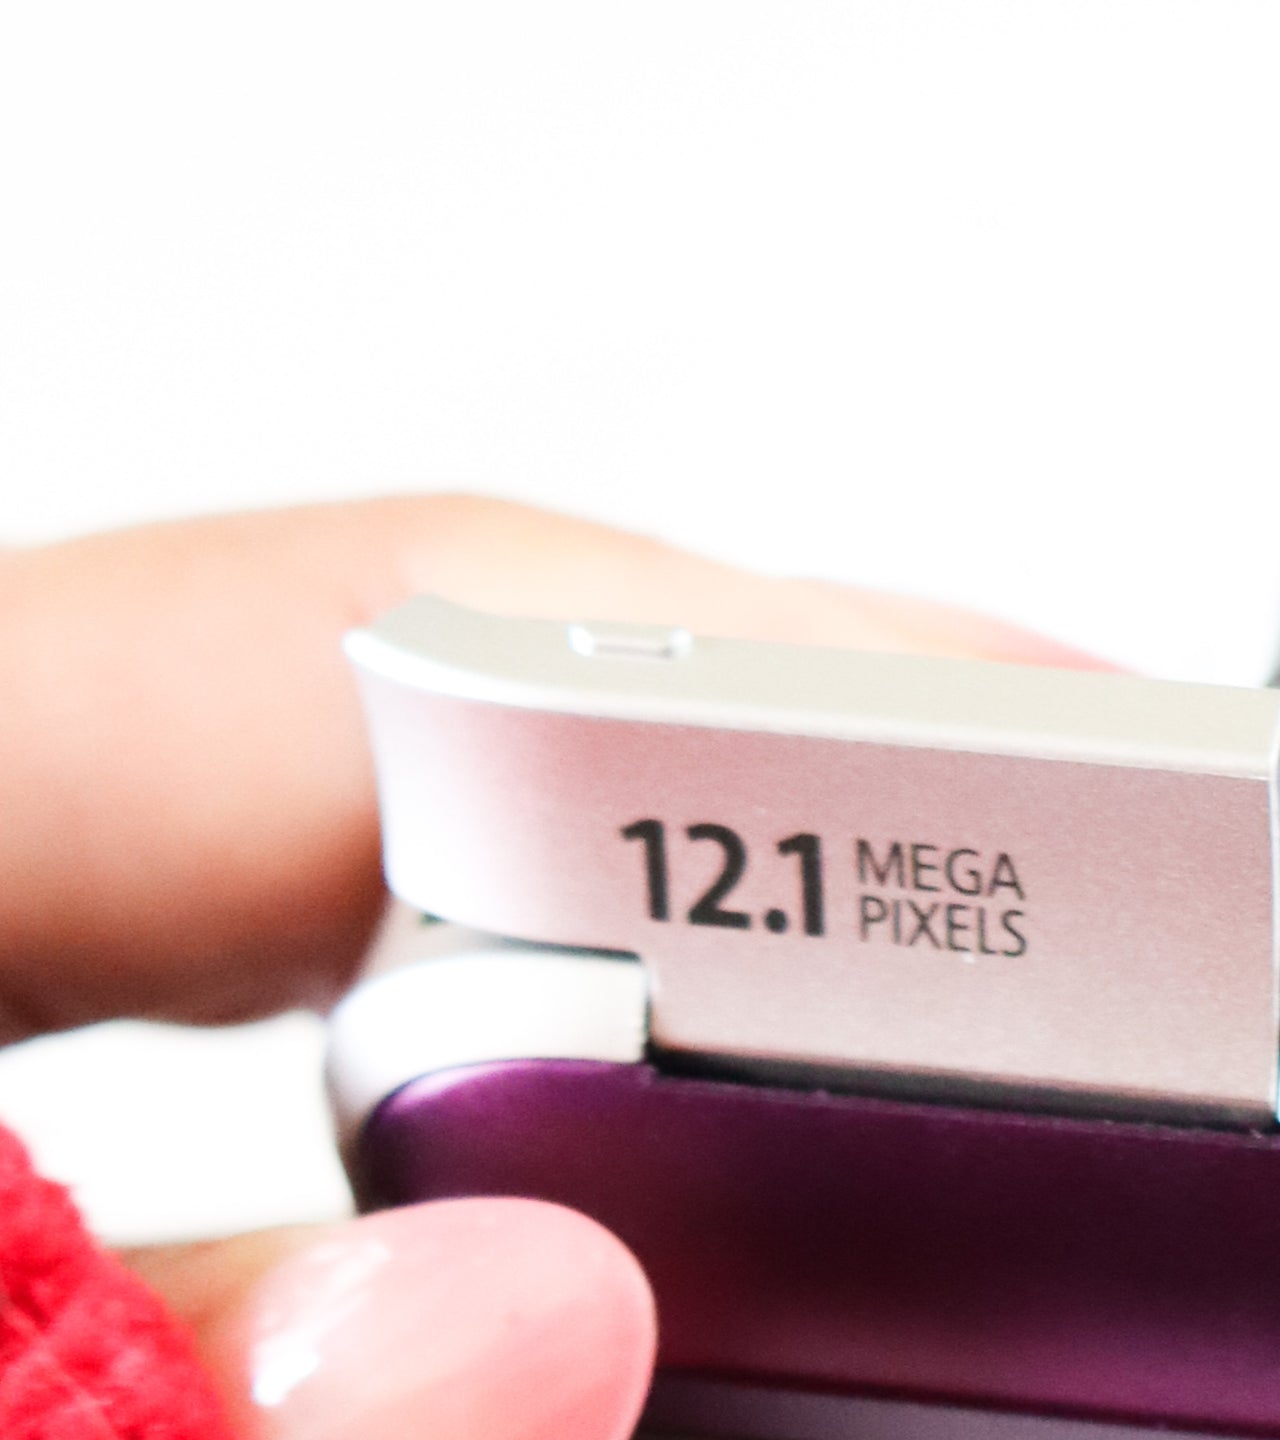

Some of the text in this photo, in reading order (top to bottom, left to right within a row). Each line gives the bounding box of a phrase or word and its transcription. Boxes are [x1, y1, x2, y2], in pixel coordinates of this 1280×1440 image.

[620, 818, 1026, 937] 12.1 MEGA
[859, 893, 1029, 958] PIXELS
